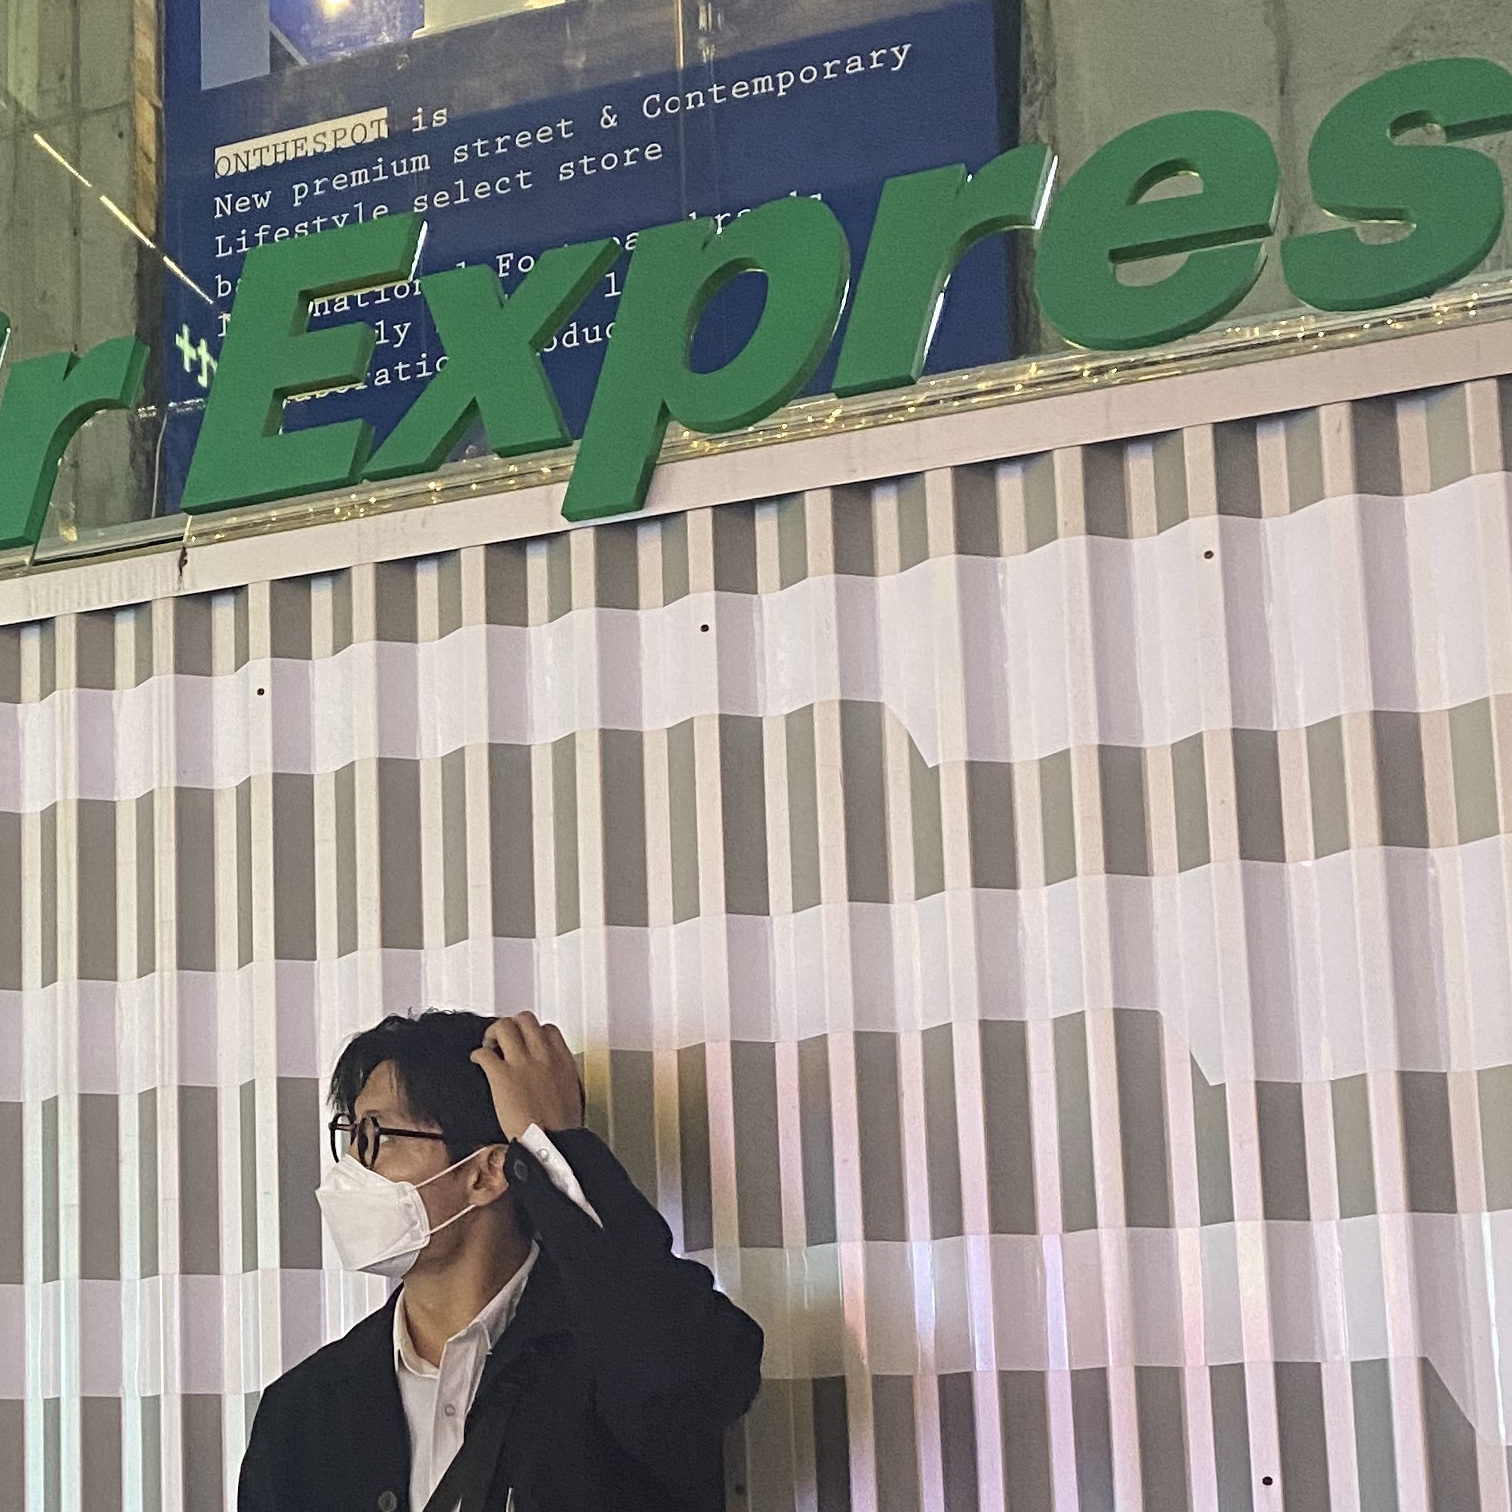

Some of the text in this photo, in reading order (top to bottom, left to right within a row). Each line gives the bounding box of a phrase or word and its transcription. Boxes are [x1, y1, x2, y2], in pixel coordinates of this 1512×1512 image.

[213, 42, 912, 219] New premium street & Contemporary
[215, 107, 448, 178] ONTHESPOT is
[413, 168, 534, 213] select
[558, 141, 663, 182] store
[180, 56, 1512, 522] Expres
